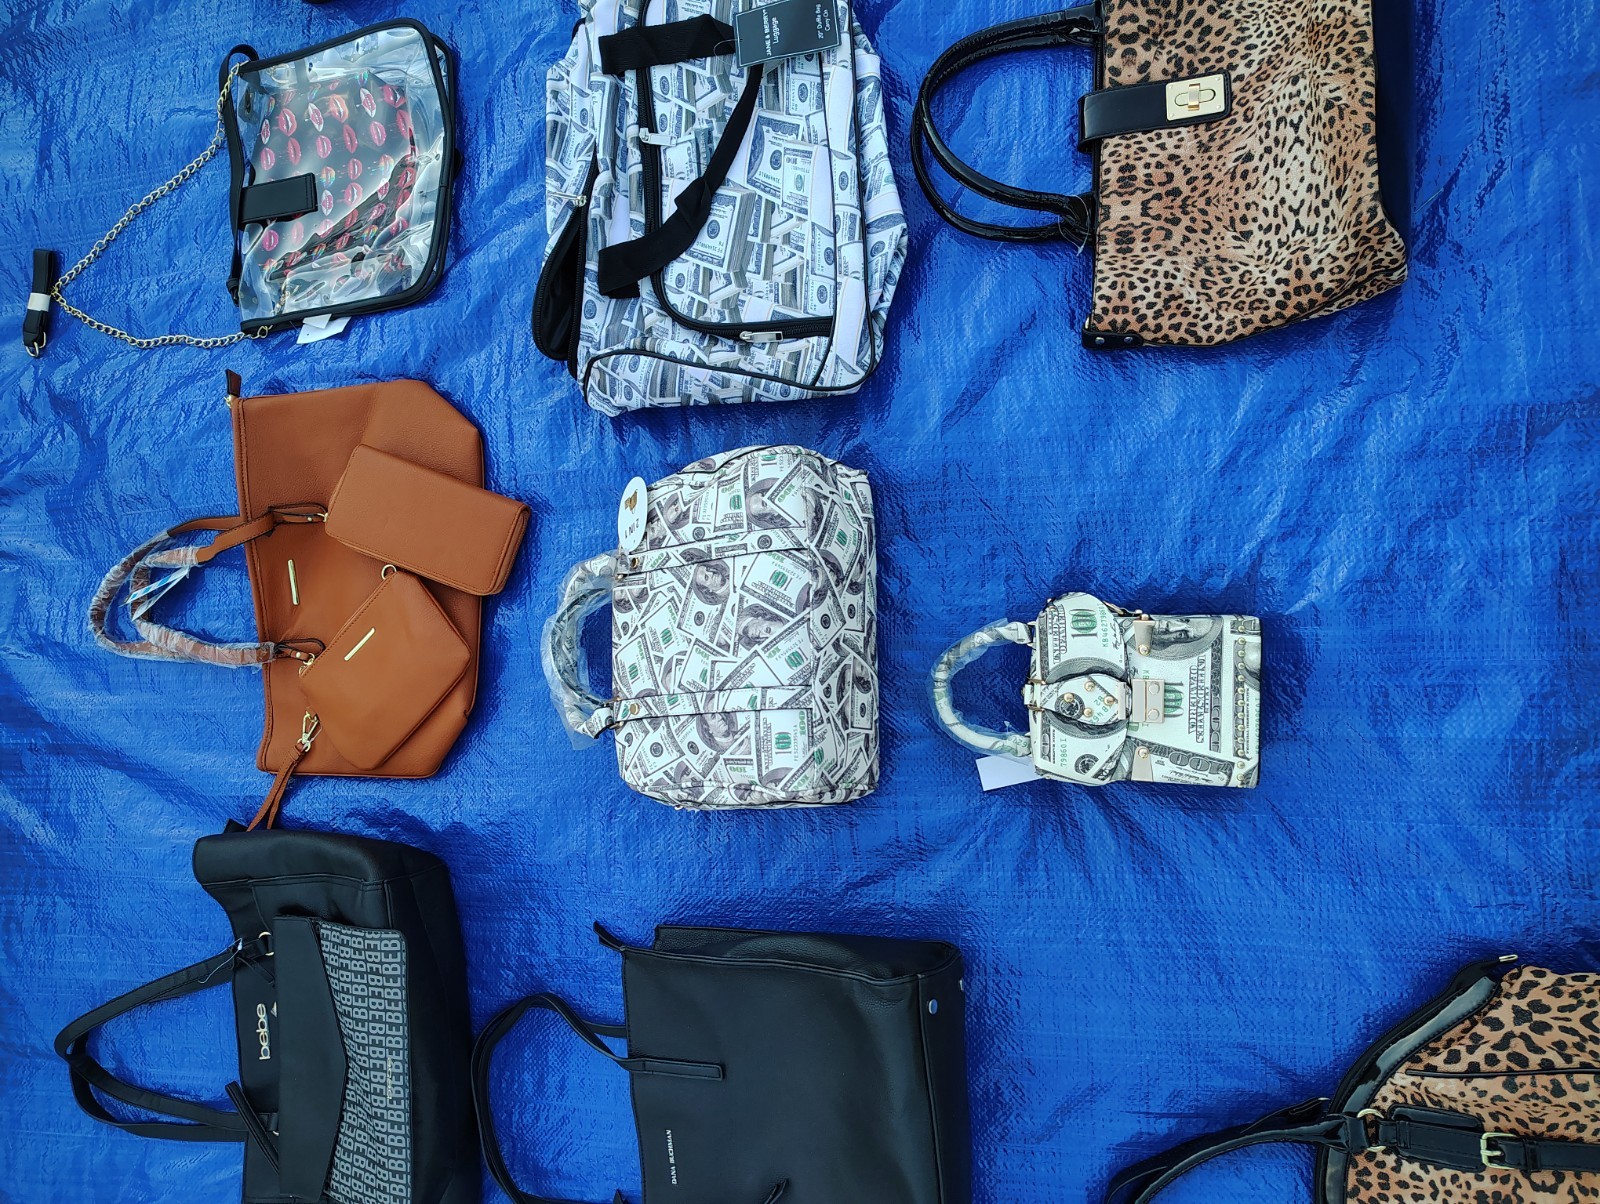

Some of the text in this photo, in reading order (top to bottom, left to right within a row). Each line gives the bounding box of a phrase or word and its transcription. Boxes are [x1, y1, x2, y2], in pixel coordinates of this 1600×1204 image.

[771, 17, 780, 44] Luggage
[822, 9, 829, 18] On
[1069, 608, 1098, 640] 100
[1196, 655, 1205, 743] UNITED STATES
[255, 1003, 271, 1061] bebe
[665, 1129, 678, 1185] DANA BUCHMAN
